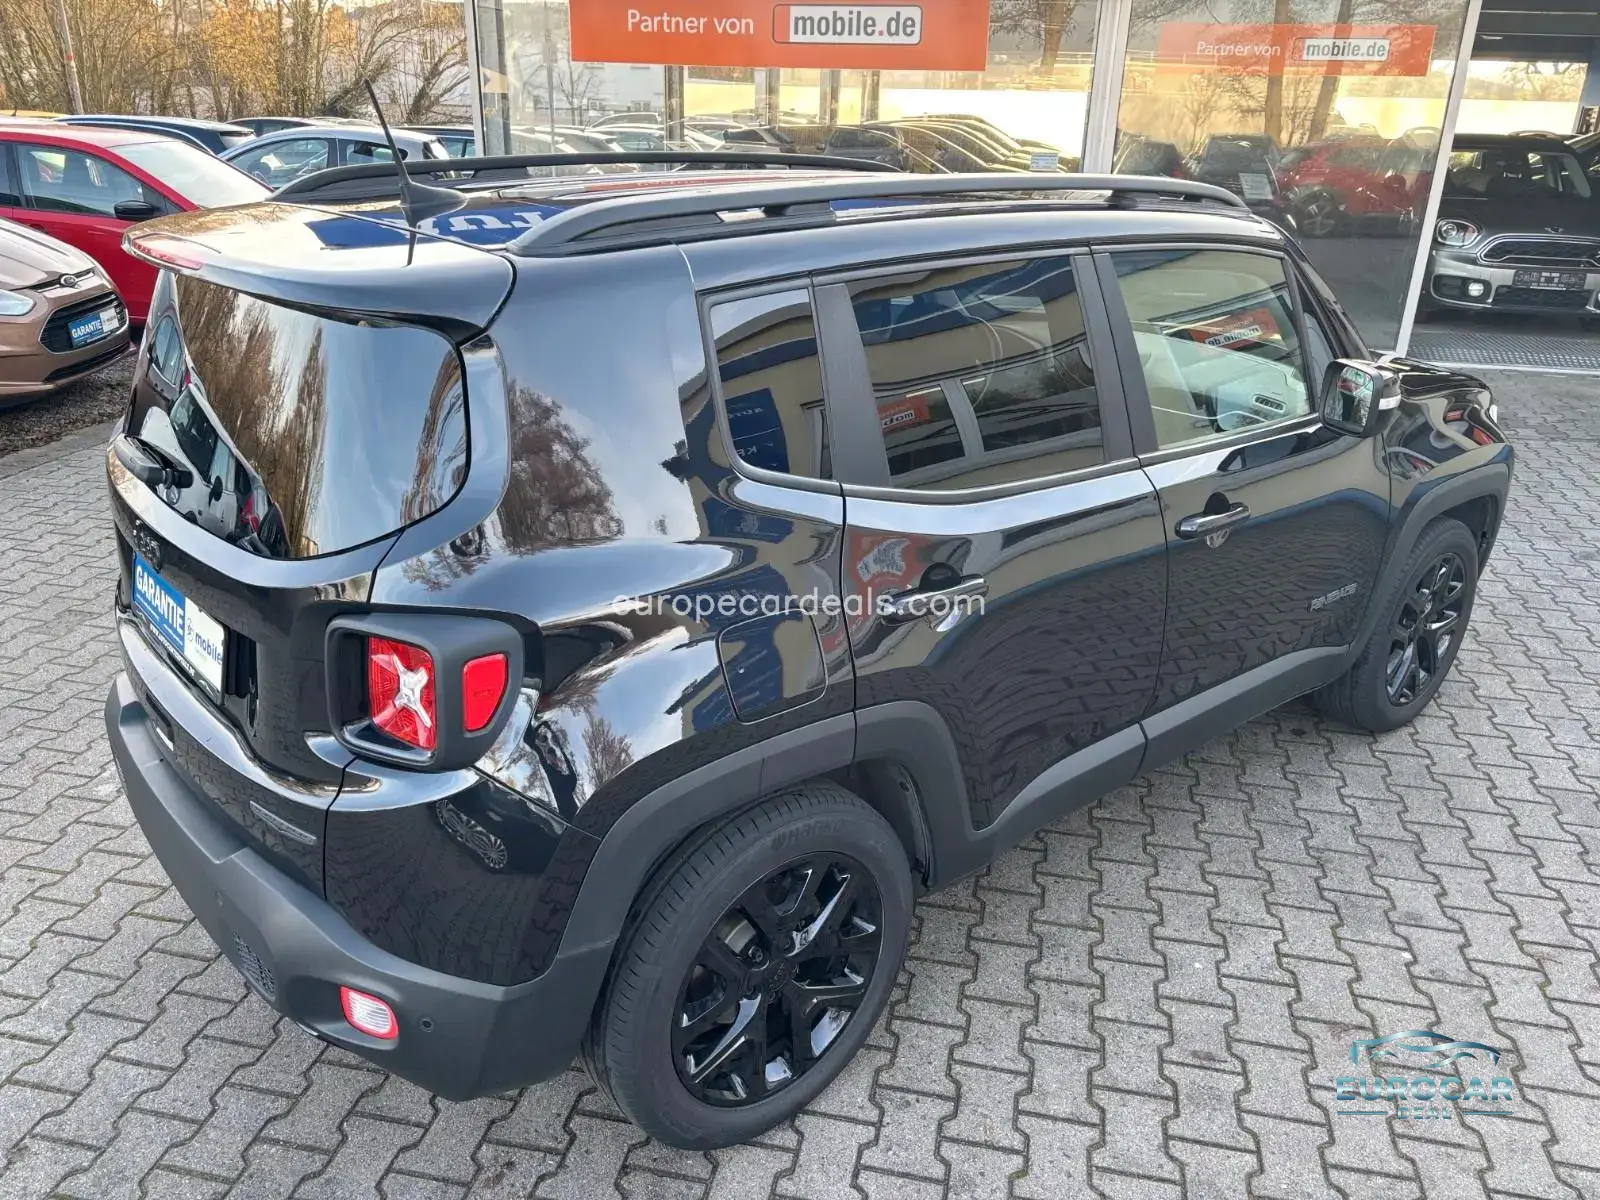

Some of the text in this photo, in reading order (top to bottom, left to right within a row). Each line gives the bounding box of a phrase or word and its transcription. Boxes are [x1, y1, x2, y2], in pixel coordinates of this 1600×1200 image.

[627, 9, 916, 37] Partner von mobile.de
[1196, 41, 1386, 58] Partner von mobile.de
[71, 319, 103, 339] GARANTIE
[136, 564, 185, 637] GARANTIE
